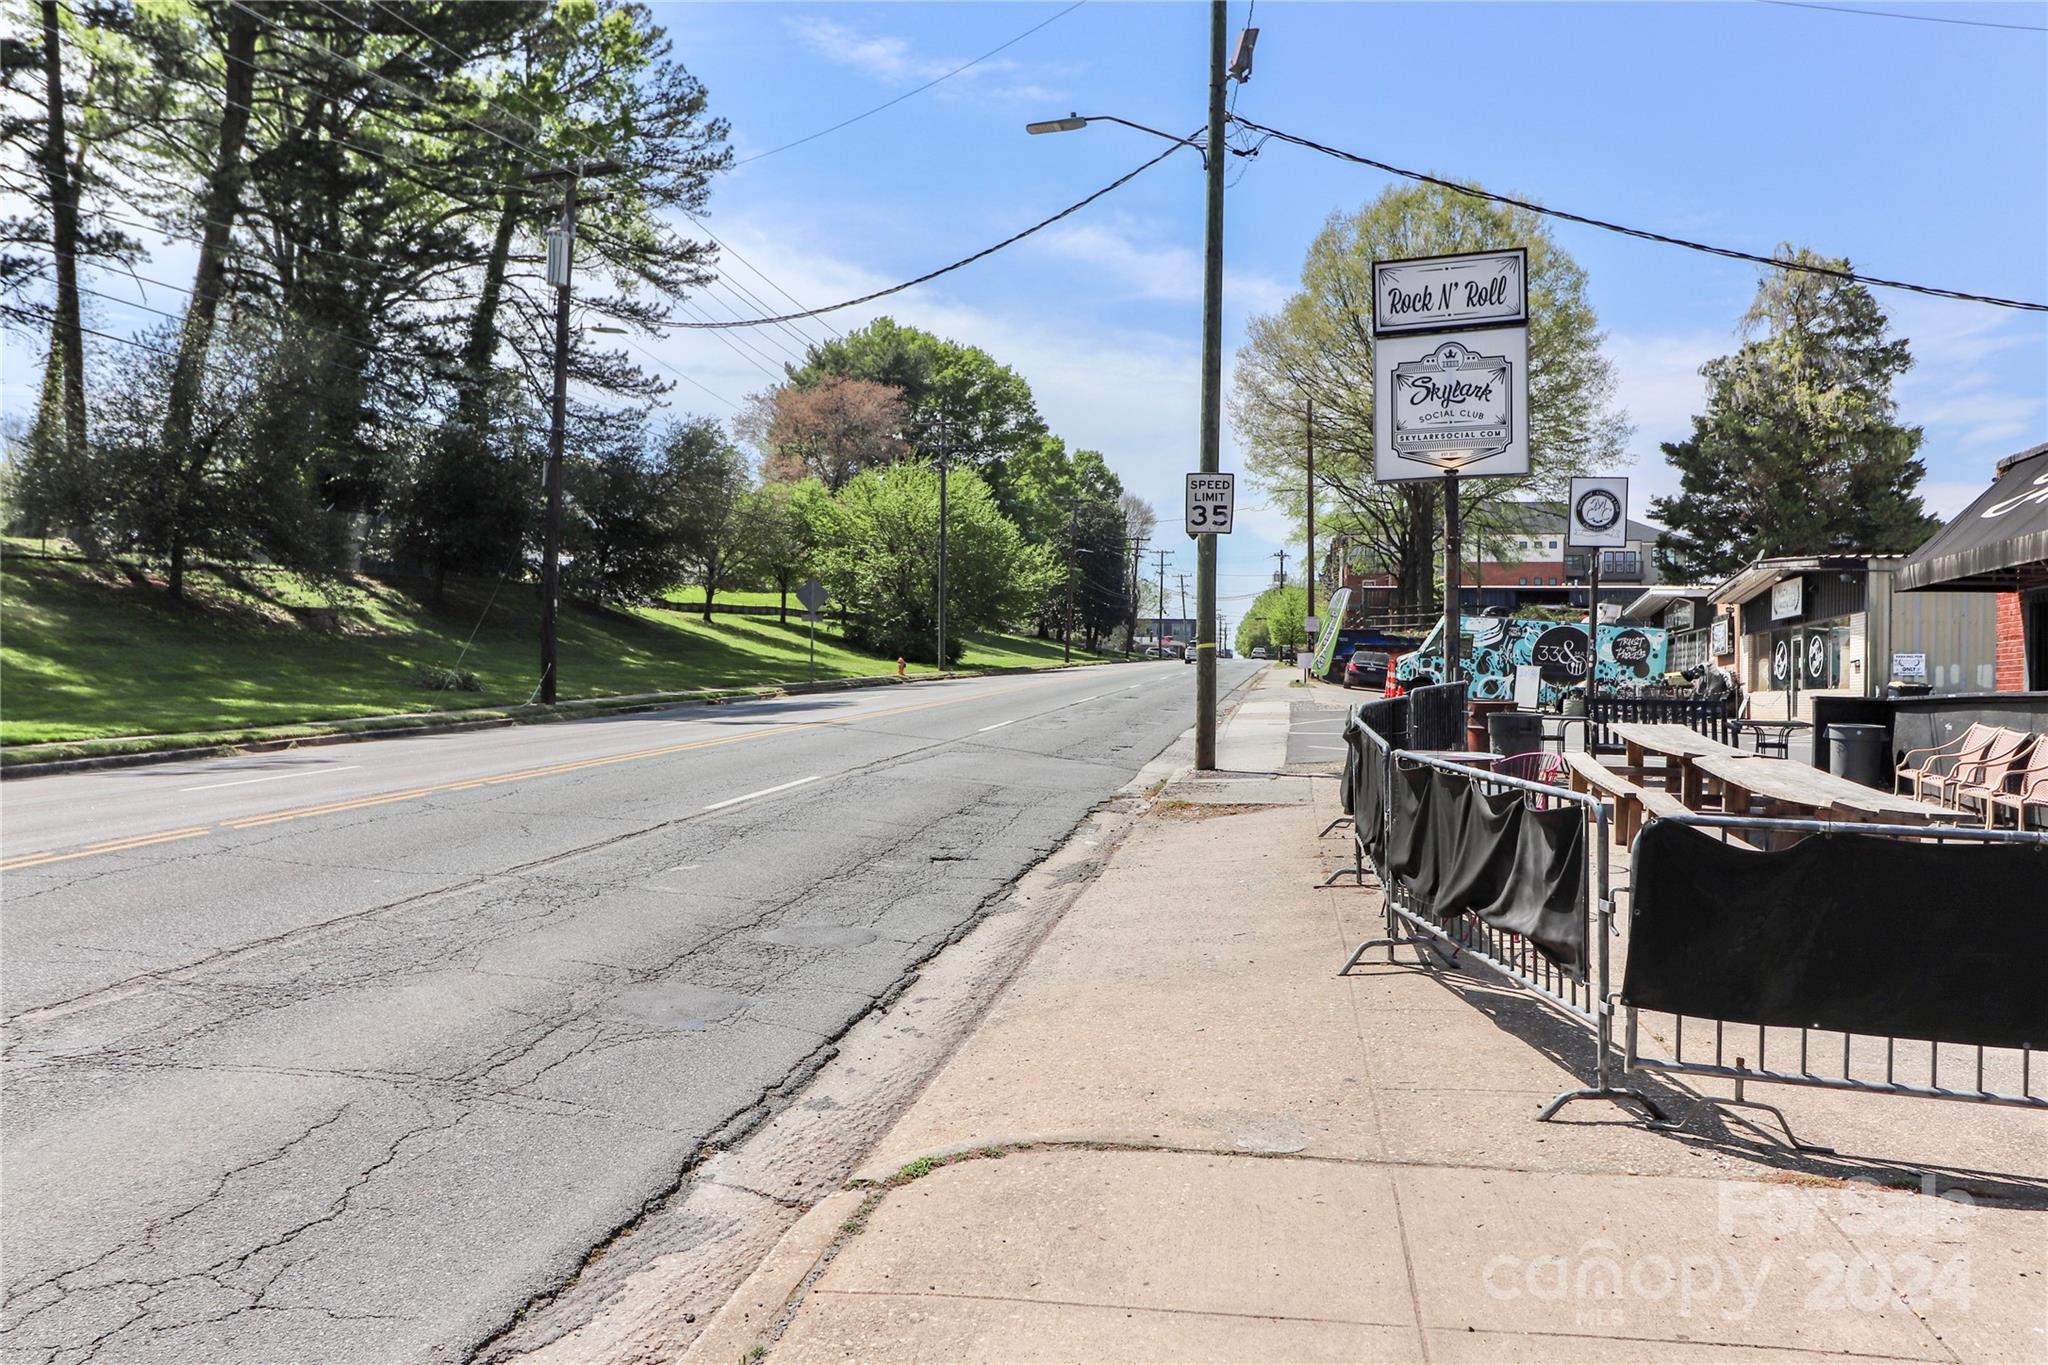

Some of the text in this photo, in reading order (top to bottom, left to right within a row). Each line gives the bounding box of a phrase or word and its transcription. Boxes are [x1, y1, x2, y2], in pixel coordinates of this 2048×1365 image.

[1388, 275, 1507, 314] Rock N' Roll
[1410, 376, 1492, 409] Skylark
[1419, 409, 1484, 423] SOCIAL CLUB
[1190, 480, 1230, 490] SPEED
[1194, 492, 1225, 502] LIMIT
[1190, 505, 1229, 527] 35
